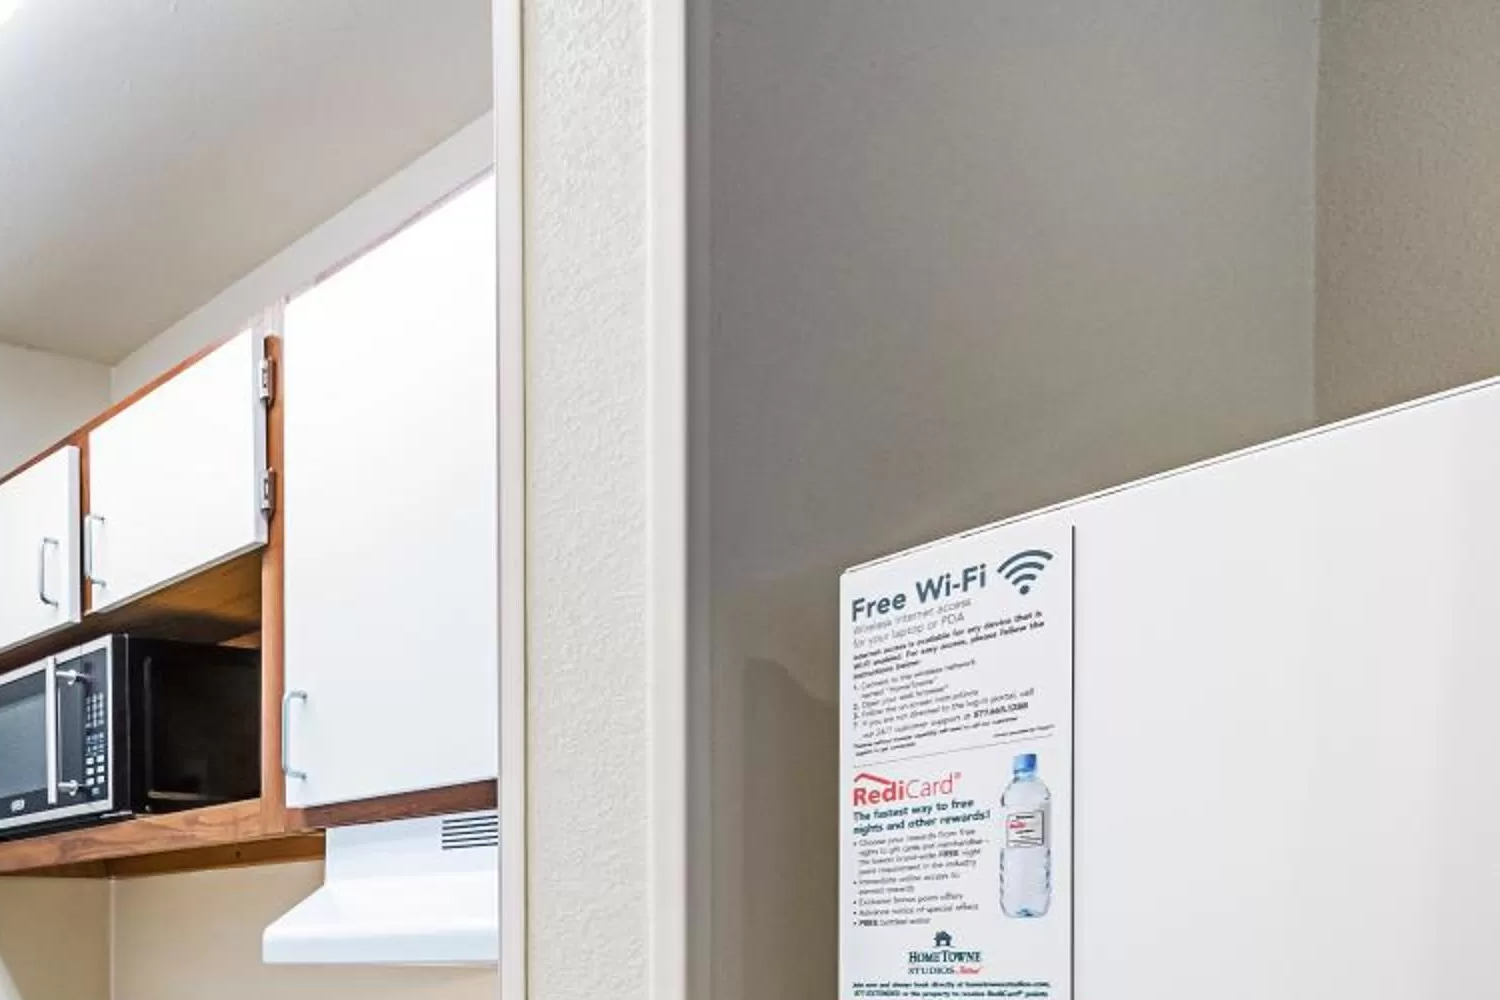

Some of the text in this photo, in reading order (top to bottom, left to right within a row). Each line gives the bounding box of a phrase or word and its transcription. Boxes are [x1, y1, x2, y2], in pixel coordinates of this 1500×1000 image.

[852, 563, 986, 622] Free Wi-Fi
[941, 612, 965, 625] PDA
[853, 798, 974, 821] The fastest way to free
[853, 809, 990, 837] nights and other rewards!
